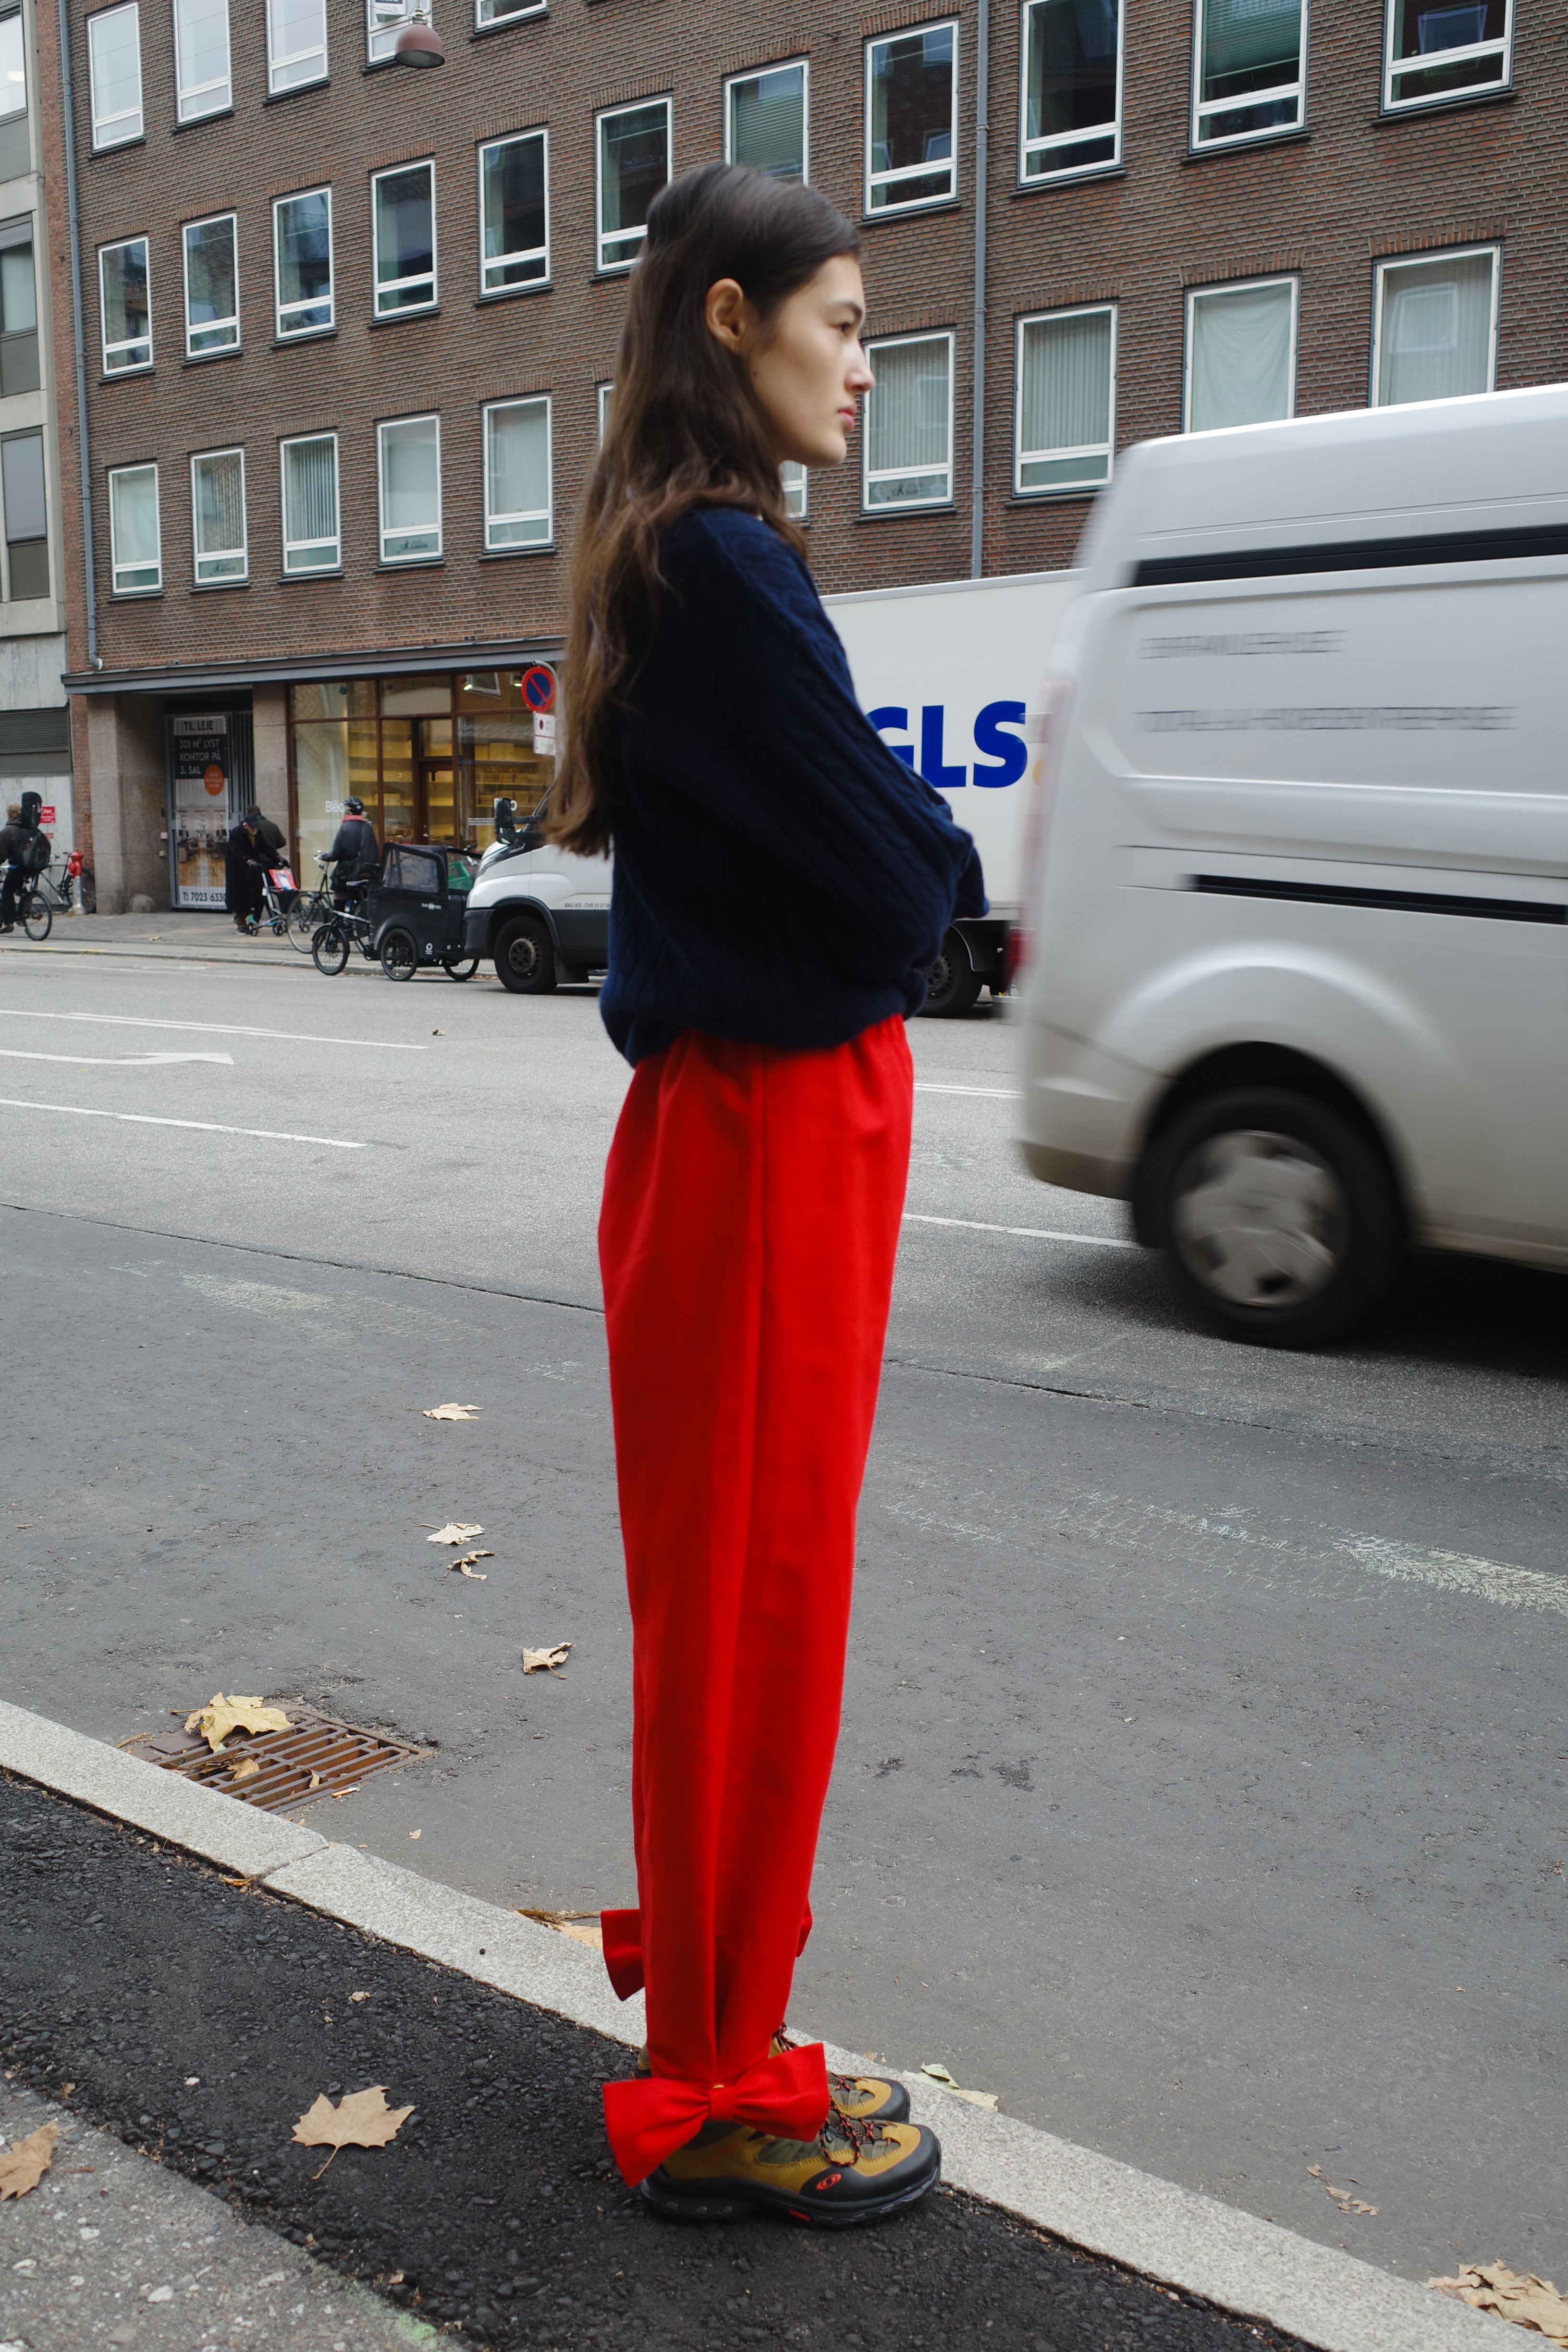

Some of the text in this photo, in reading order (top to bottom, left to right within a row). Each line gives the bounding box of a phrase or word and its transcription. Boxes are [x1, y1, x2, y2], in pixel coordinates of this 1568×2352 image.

[184, 721, 213, 731] TIL LEJE
[179, 740, 191, 748] 301
[204, 738, 220, 748] LYST
[865, 700, 1028, 788] GLS
[180, 749, 221, 761] KONTOR PÅ
[180, 765, 201, 774] 3. SAL
[183, 892, 188, 901] T:
[191, 892, 207, 901] 7023
